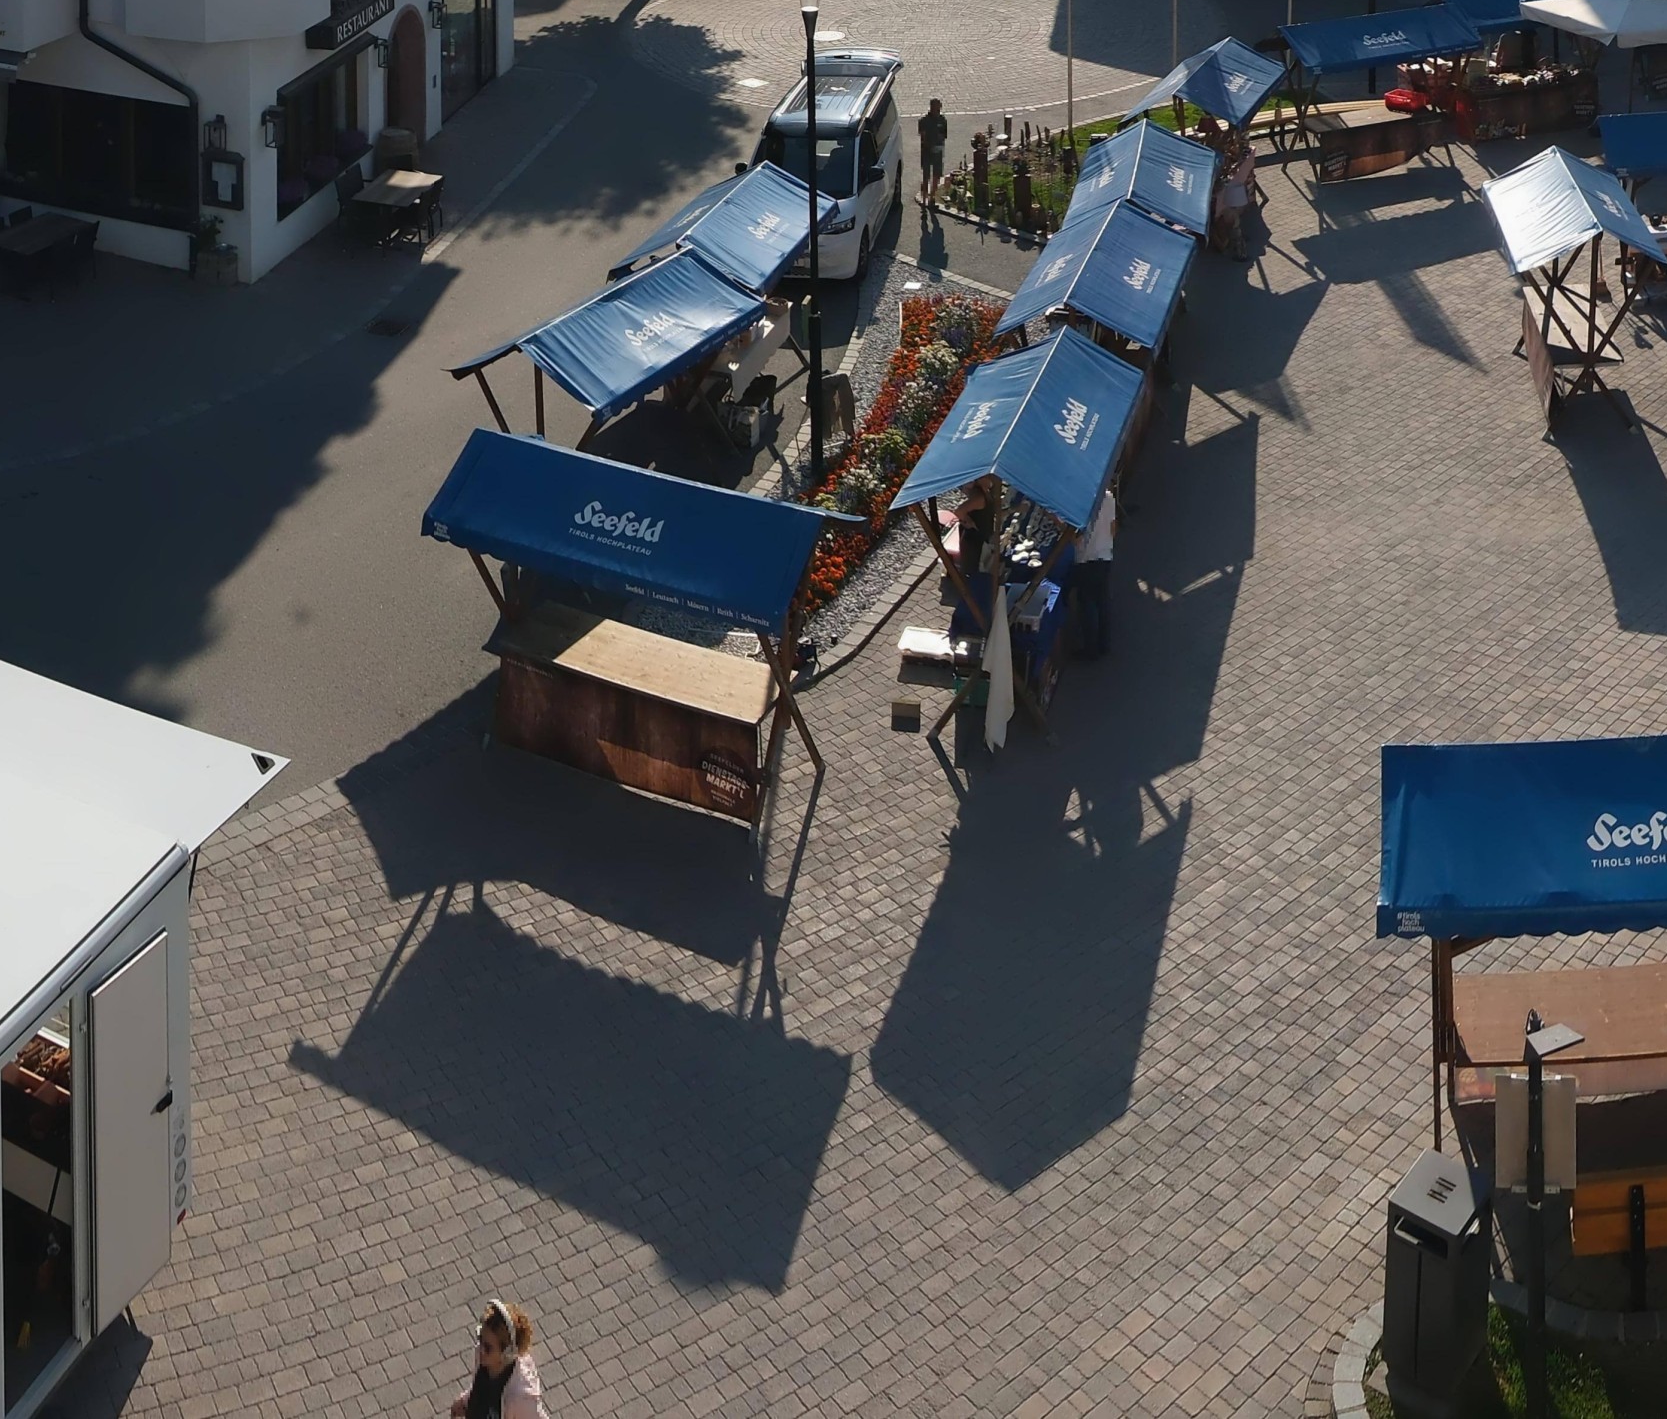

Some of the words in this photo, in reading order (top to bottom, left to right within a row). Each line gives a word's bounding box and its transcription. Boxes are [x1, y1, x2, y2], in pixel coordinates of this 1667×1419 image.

[1362, 30, 1407, 47] Seefeld
[624, 312, 676, 346] Seefeld
[1053, 396, 1088, 445] Seefeld
[574, 500, 664, 544] Seefeld
[568, 527, 595, 541] TIROLS
[597, 535, 652, 556] HOCHPLATEAU
[1591, 857, 1631, 869] TIROLS
